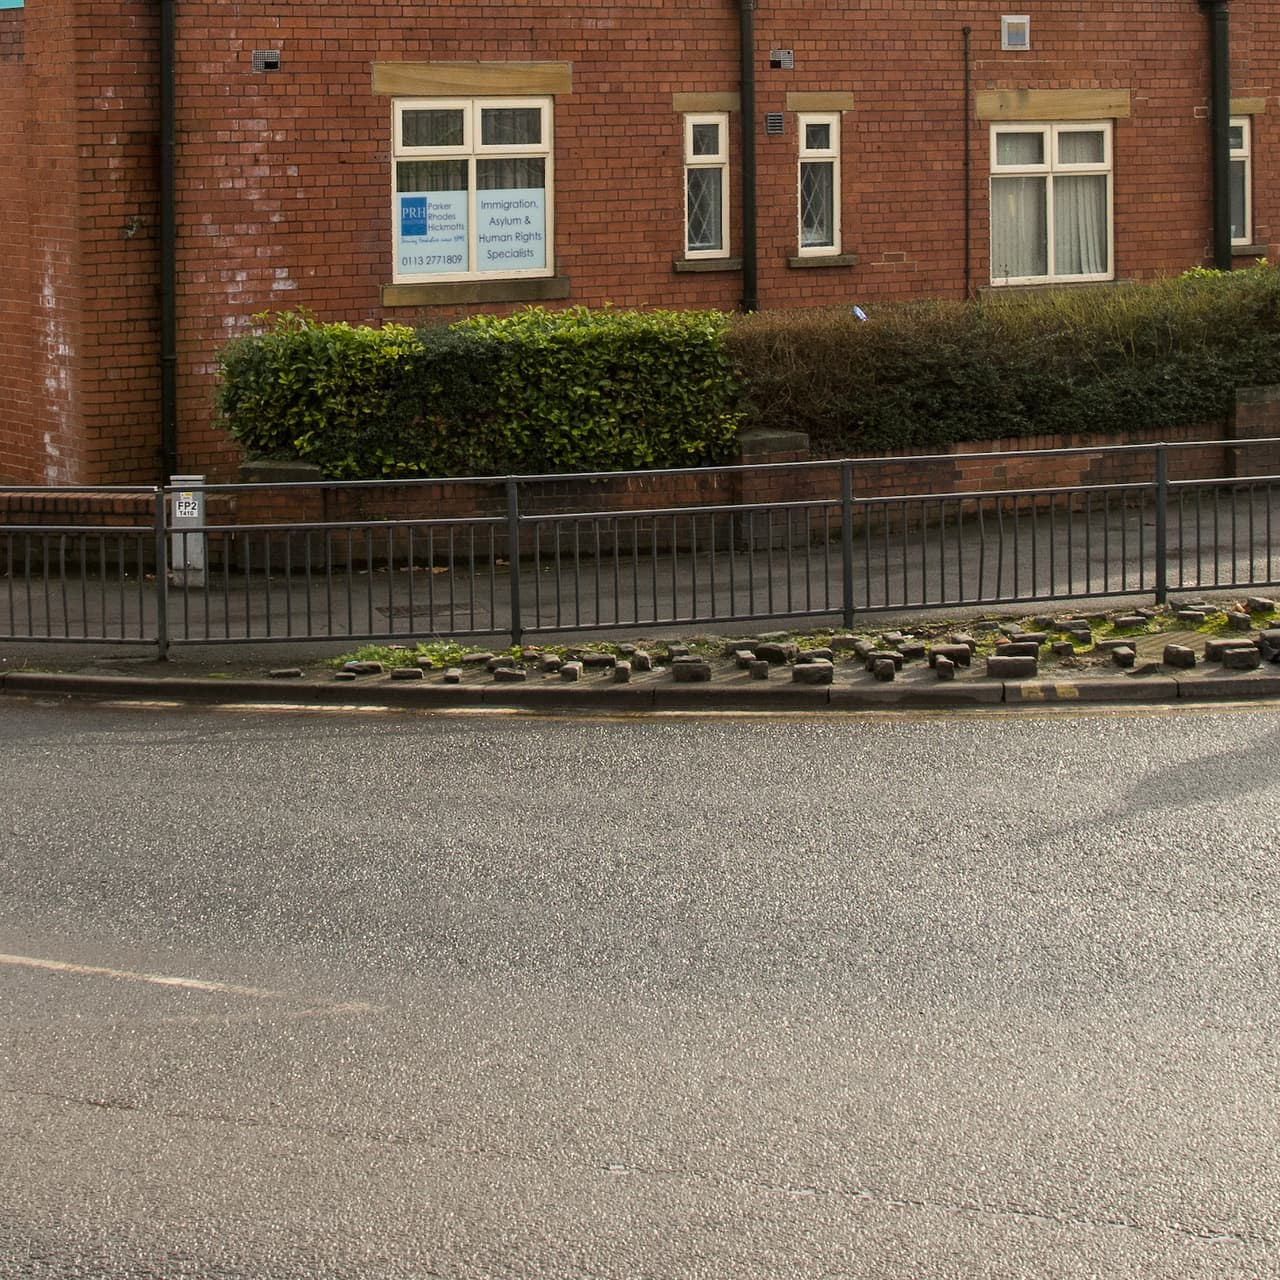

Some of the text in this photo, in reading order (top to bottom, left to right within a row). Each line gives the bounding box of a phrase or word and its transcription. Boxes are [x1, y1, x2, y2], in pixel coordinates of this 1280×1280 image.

[402, 207, 426, 219] PRH
[428, 213, 456, 221] Rhodes
[489, 215, 531, 227] Asylum &
[479, 231, 543, 243] Human Rights
[402, 255, 424, 266] 0113
[487, 248, 534, 261] Specialists
[178, 501, 196, 510] FP2
